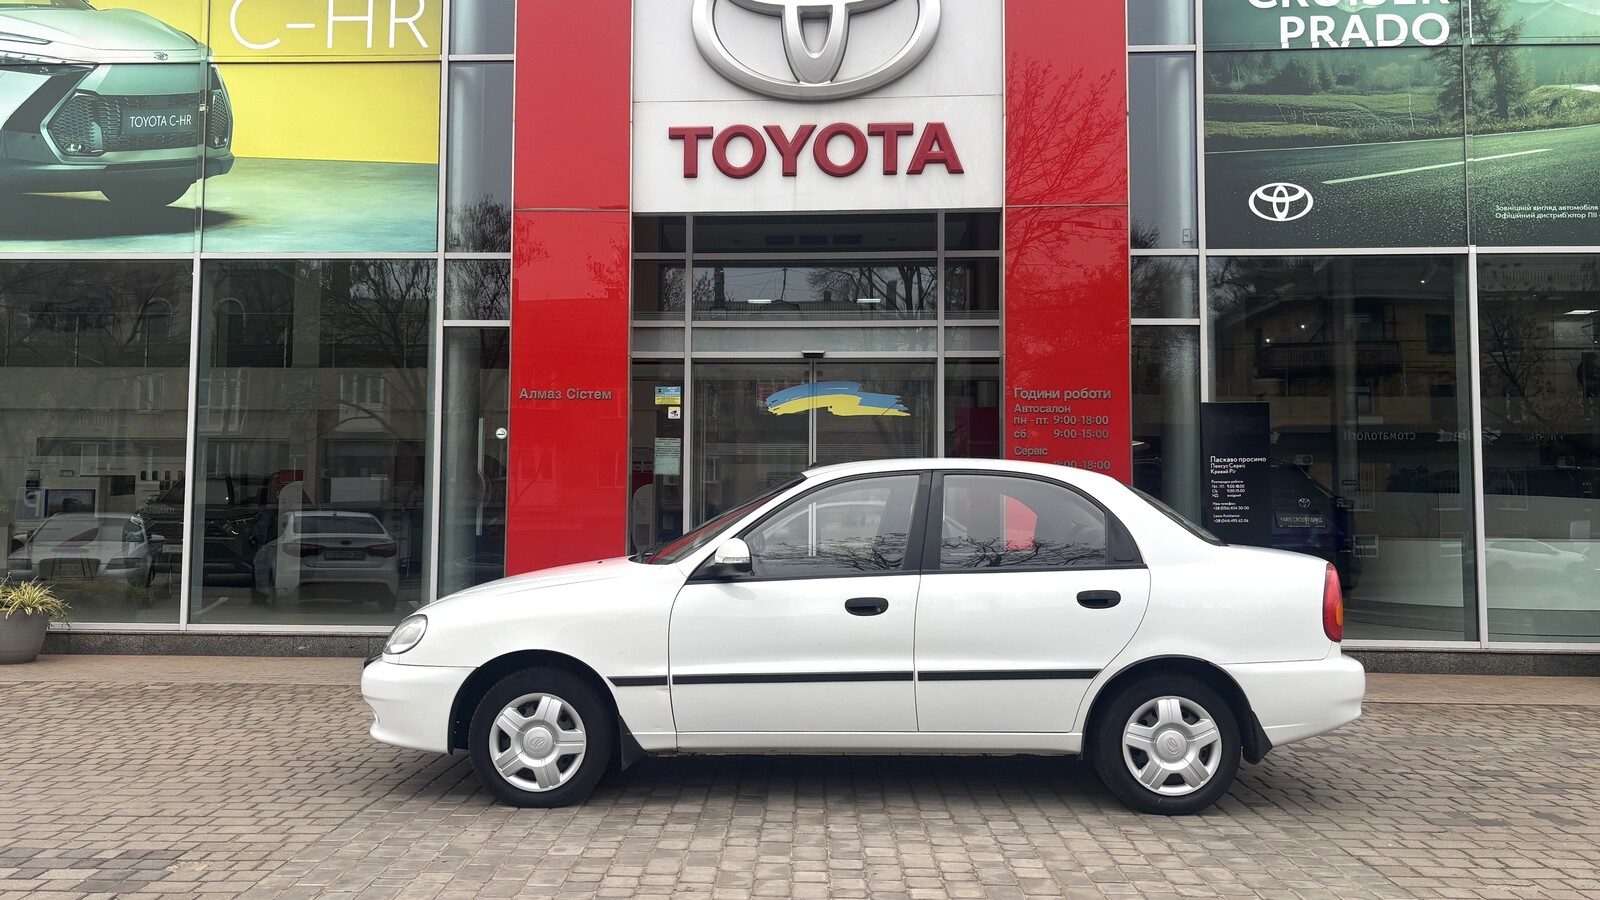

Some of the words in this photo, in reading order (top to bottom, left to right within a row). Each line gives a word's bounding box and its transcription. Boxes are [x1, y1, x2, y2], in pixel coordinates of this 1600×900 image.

[230, 0, 429, 49] C-HR
[1280, 13, 1450, 48] PRADO
[130, 116, 167, 128] TOYOTA
[170, 114, 192, 126] C-HR
[668, 122, 964, 178] TOYOTA
[519, 388, 562, 399] Алмаз
[566, 388, 612, 399] Сістем
[1014, 388, 1060, 400] Години
[1064, 388, 1112, 401] роботи
[1014, 404, 1071, 413] Автосалон
[1014, 429, 1030, 438] сб.
[1014, 446, 1048, 457] Сервіс
